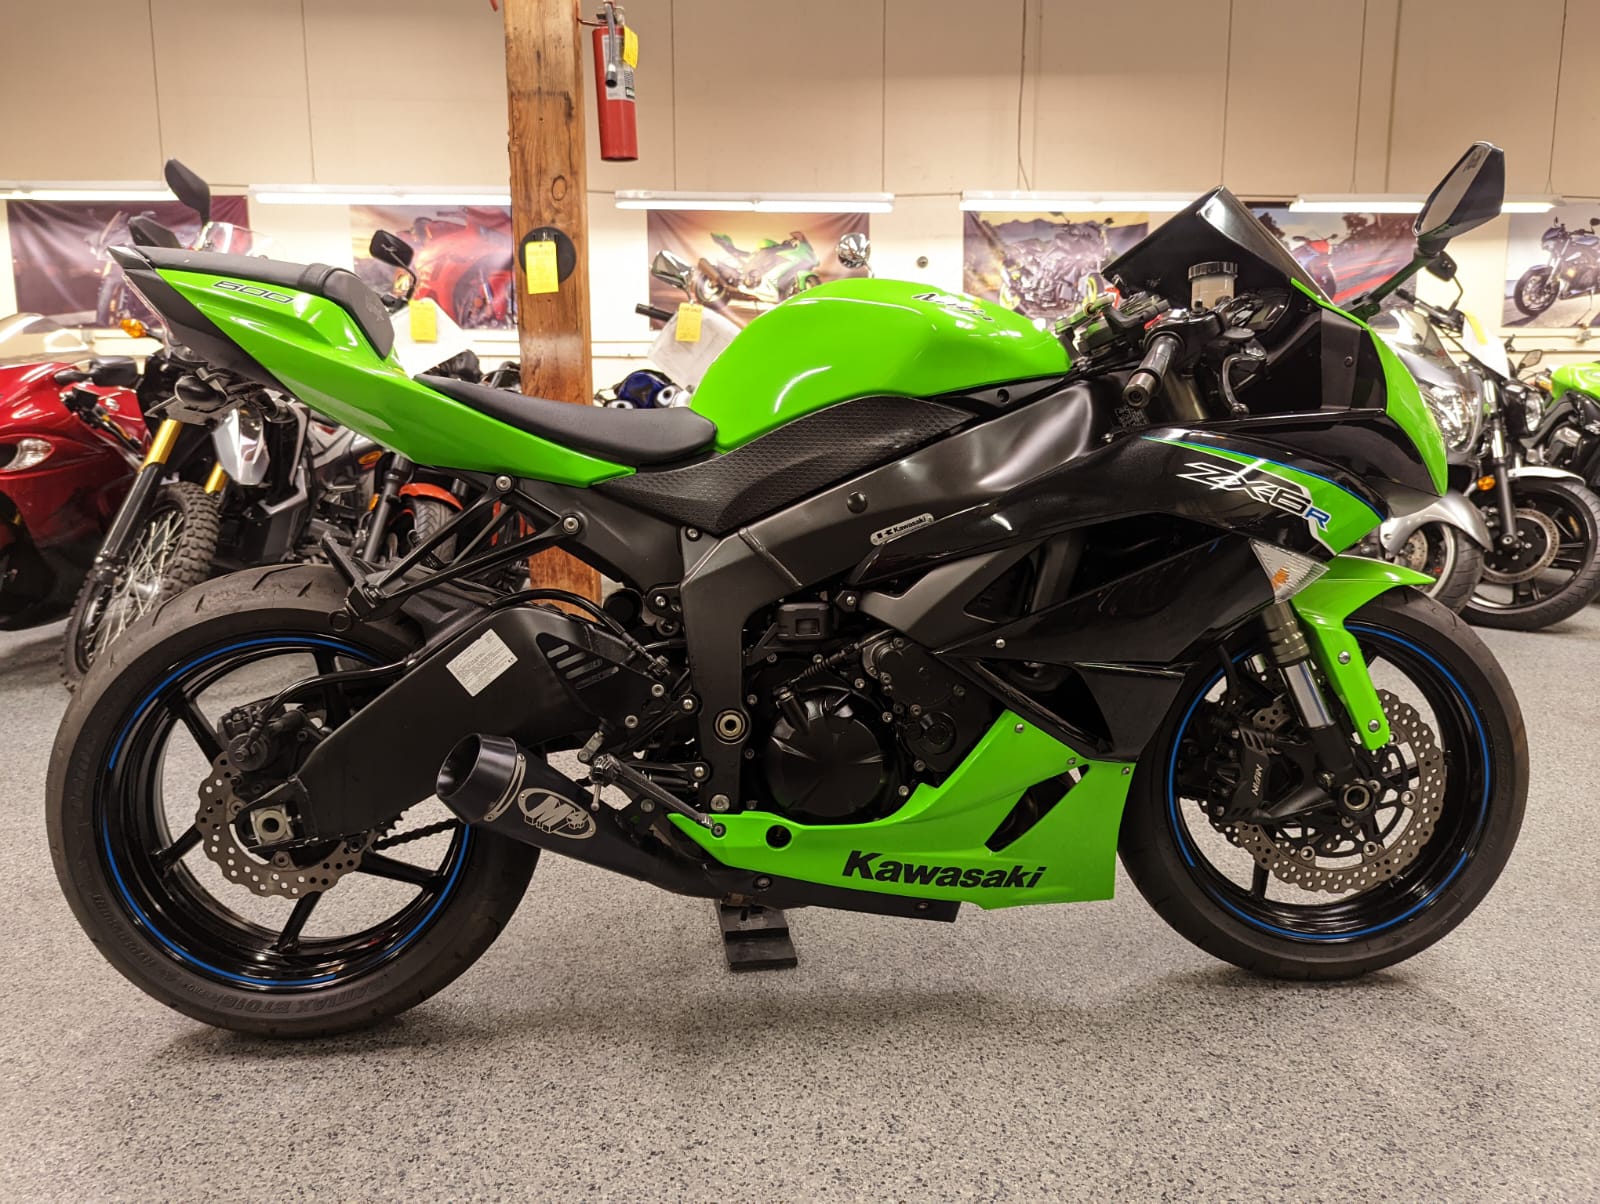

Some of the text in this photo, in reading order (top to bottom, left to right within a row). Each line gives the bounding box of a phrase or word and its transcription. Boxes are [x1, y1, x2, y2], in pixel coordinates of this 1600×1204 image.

[213, 280, 294, 304] 600
[893, 515, 926, 534] Kawasaki
[841, 850, 1048, 889] Kawasaki
